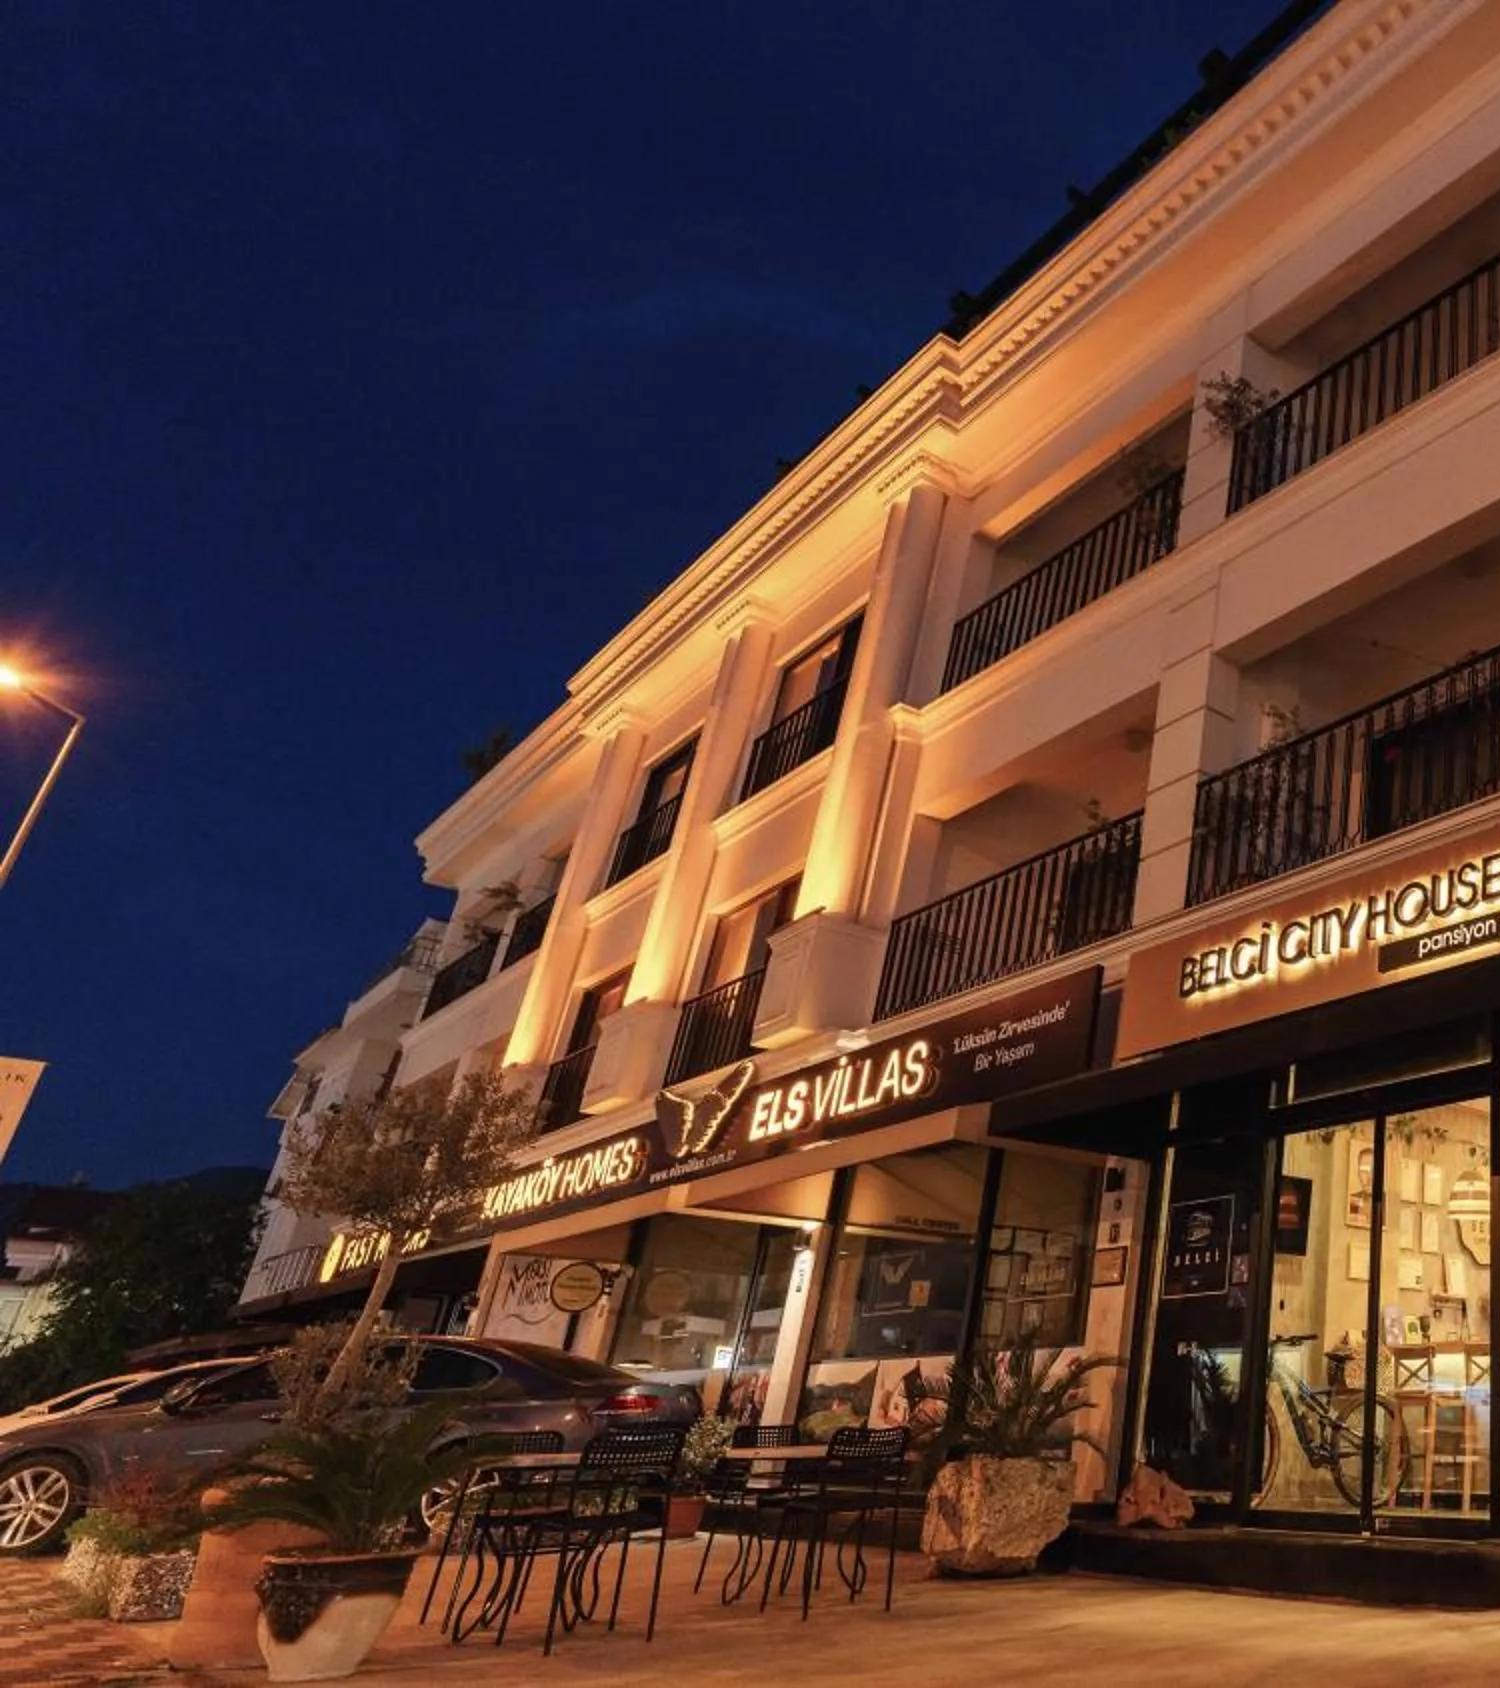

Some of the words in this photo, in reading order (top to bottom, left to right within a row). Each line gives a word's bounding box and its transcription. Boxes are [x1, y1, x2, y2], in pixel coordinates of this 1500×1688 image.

[1278, 902, 1361, 965] CITY
[1418, 918, 1498, 958] pansiyon
[974, 1053, 993, 1073] Bir
[749, 1081, 809, 1142] ELS
[481, 1156, 564, 1219] KAYAKÖY
[559, 1137, 638, 1199] HOMES
[339, 1231, 379, 1273] FAST
